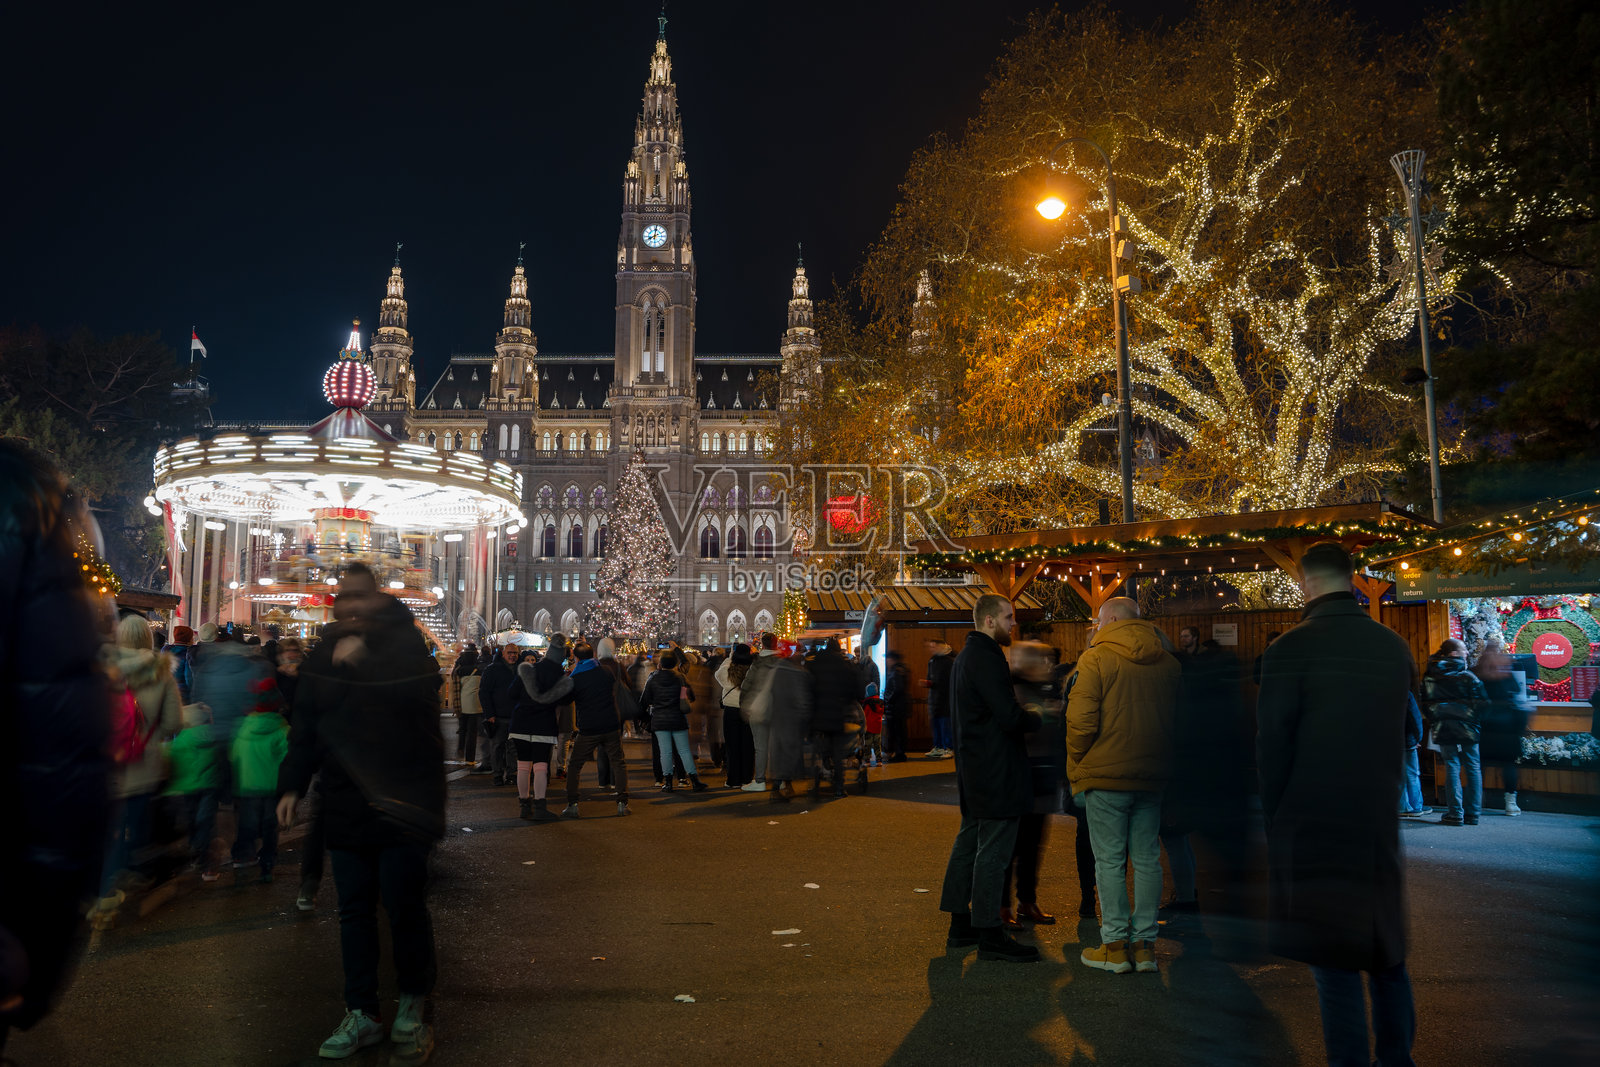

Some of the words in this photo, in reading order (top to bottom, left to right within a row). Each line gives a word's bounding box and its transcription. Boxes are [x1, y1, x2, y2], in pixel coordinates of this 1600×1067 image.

[1409, 580, 1416, 588] &
[1402, 588, 1423, 597] return
[1540, 648, 1565, 656] Navidad
